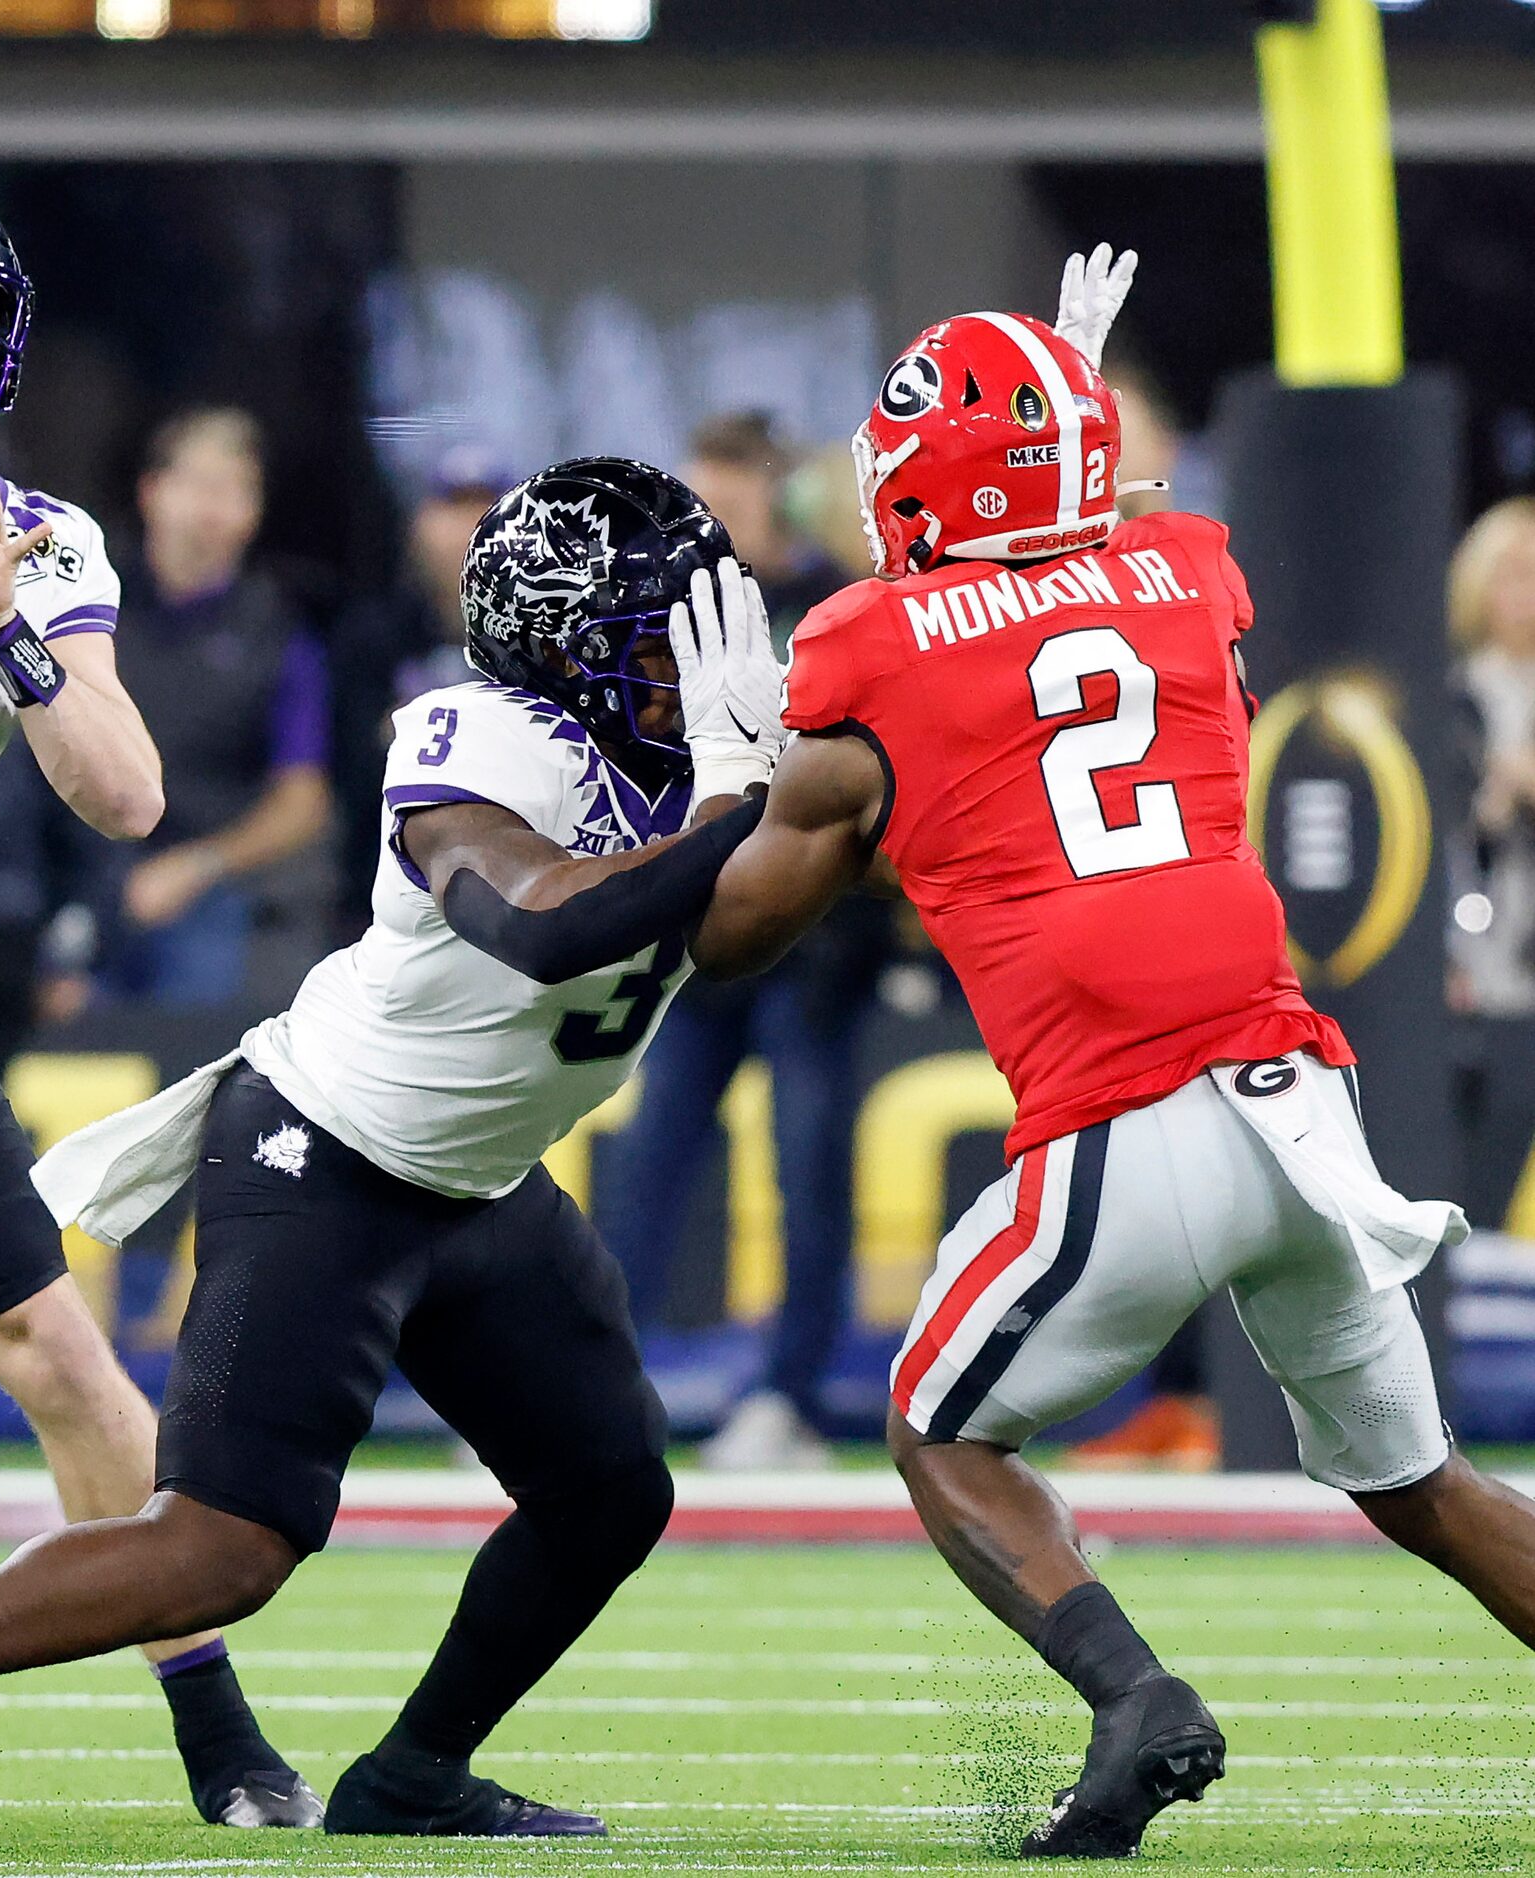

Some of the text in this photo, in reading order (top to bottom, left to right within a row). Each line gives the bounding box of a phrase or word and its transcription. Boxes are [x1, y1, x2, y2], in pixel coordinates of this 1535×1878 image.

[1085, 449, 1106, 500] 2
[977, 490, 1003, 515] SEC
[1008, 523, 1108, 554] GEORGIA
[901, 548, 1200, 652] MONDON JR.
[417, 707, 458, 767] 3
[1026, 625, 1193, 881] 2
[564, 825, 614, 857] XII
[1231, 1054, 1301, 1100] G
